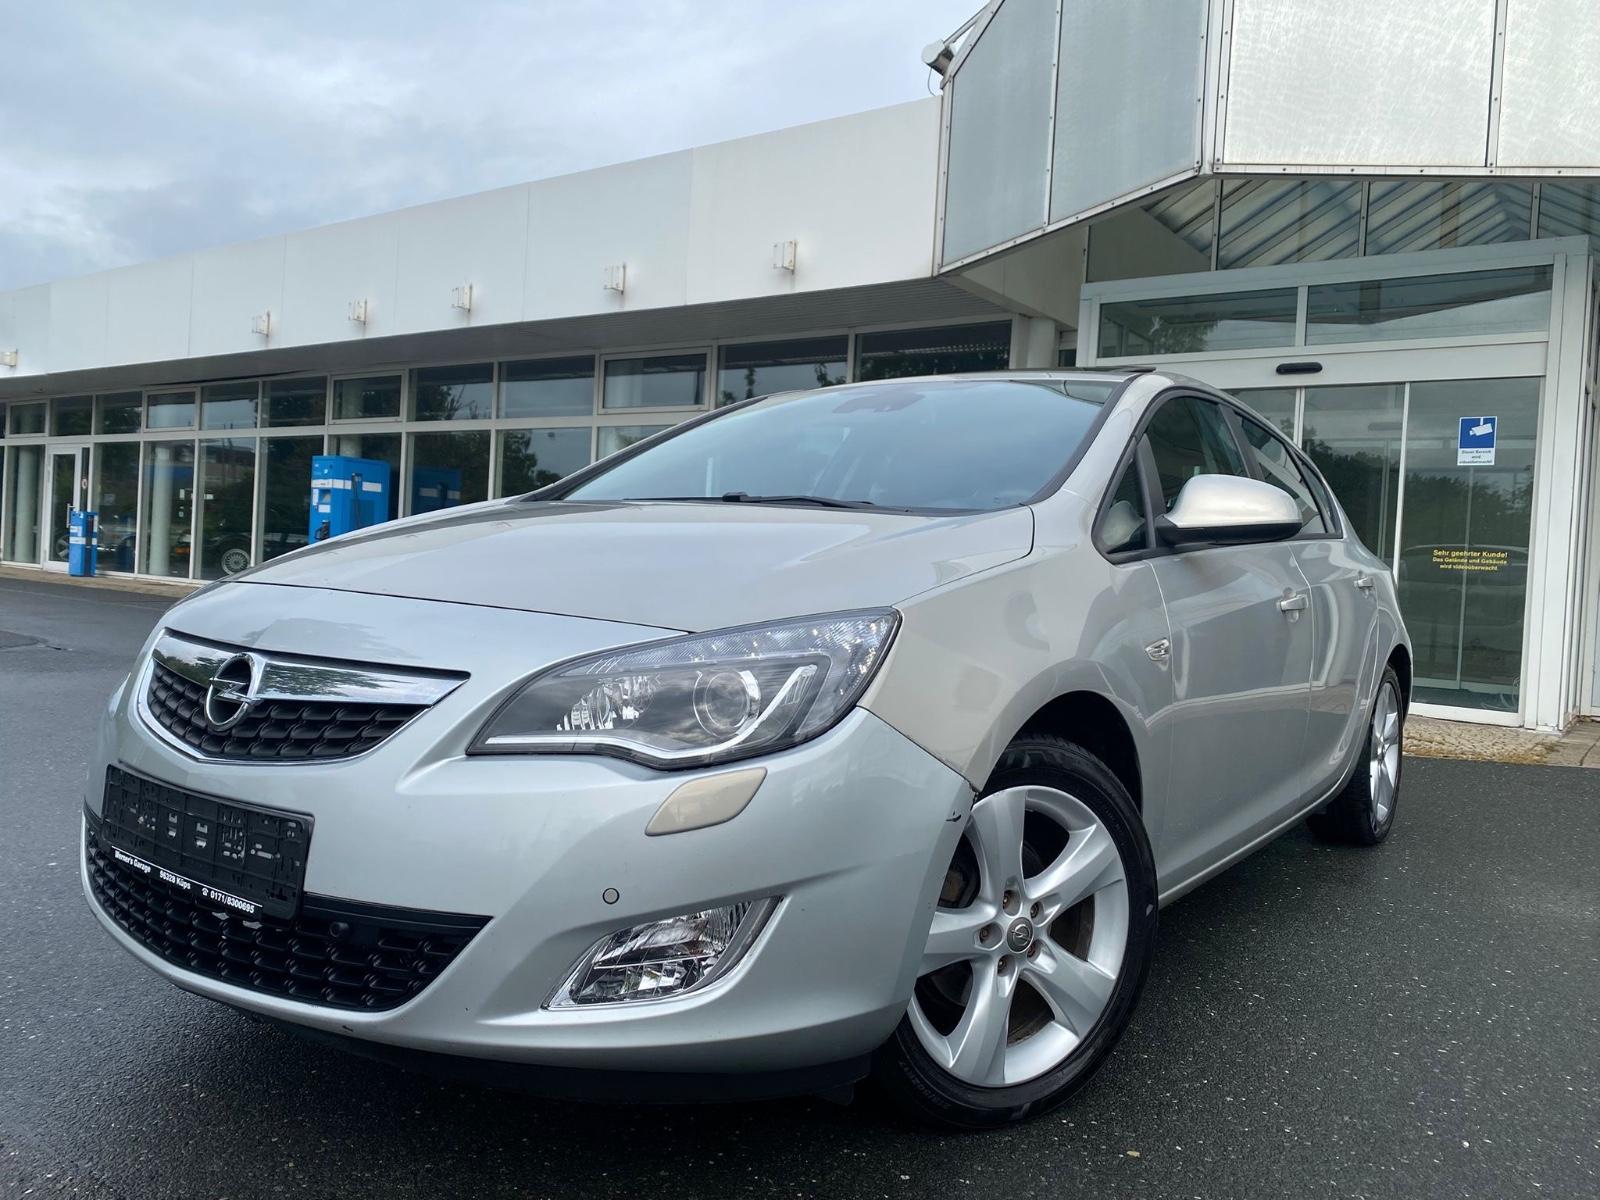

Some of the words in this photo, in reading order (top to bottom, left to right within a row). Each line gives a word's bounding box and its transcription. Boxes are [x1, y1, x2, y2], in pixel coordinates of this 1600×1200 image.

[114, 850, 133, 865] Werner's
[133, 859, 151, 873] Garage
[159, 870, 176, 883] 96328
[176, 878, 191, 890] Küps
[210, 891, 255, 914] 0171/8300695
